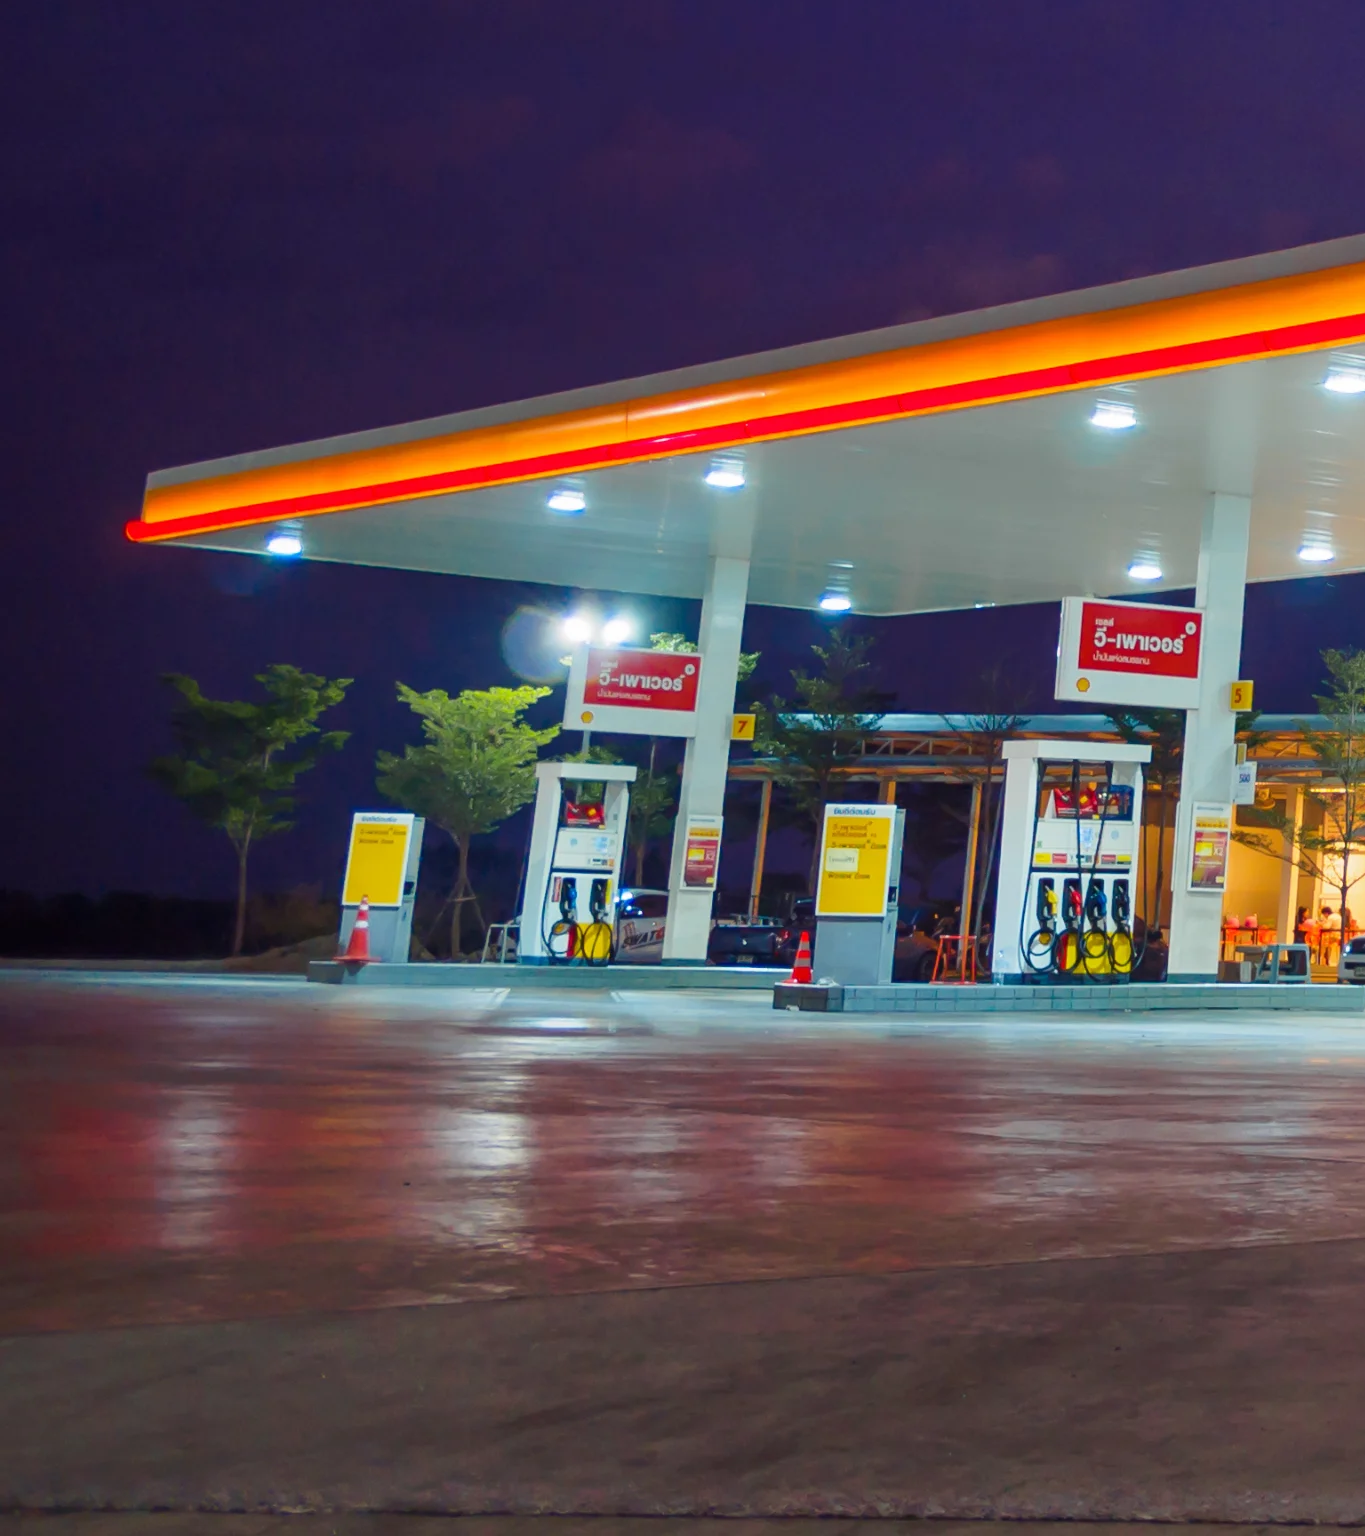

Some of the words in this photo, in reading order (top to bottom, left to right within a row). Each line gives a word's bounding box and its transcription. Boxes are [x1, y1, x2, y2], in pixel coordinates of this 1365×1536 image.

[1094, 627, 1187, 654] วี-เพาเวอร์
[599, 668, 685, 692] วี-เพาเวอร์
[1234, 688, 1242, 703] 5
[737, 720, 748, 733] 7
